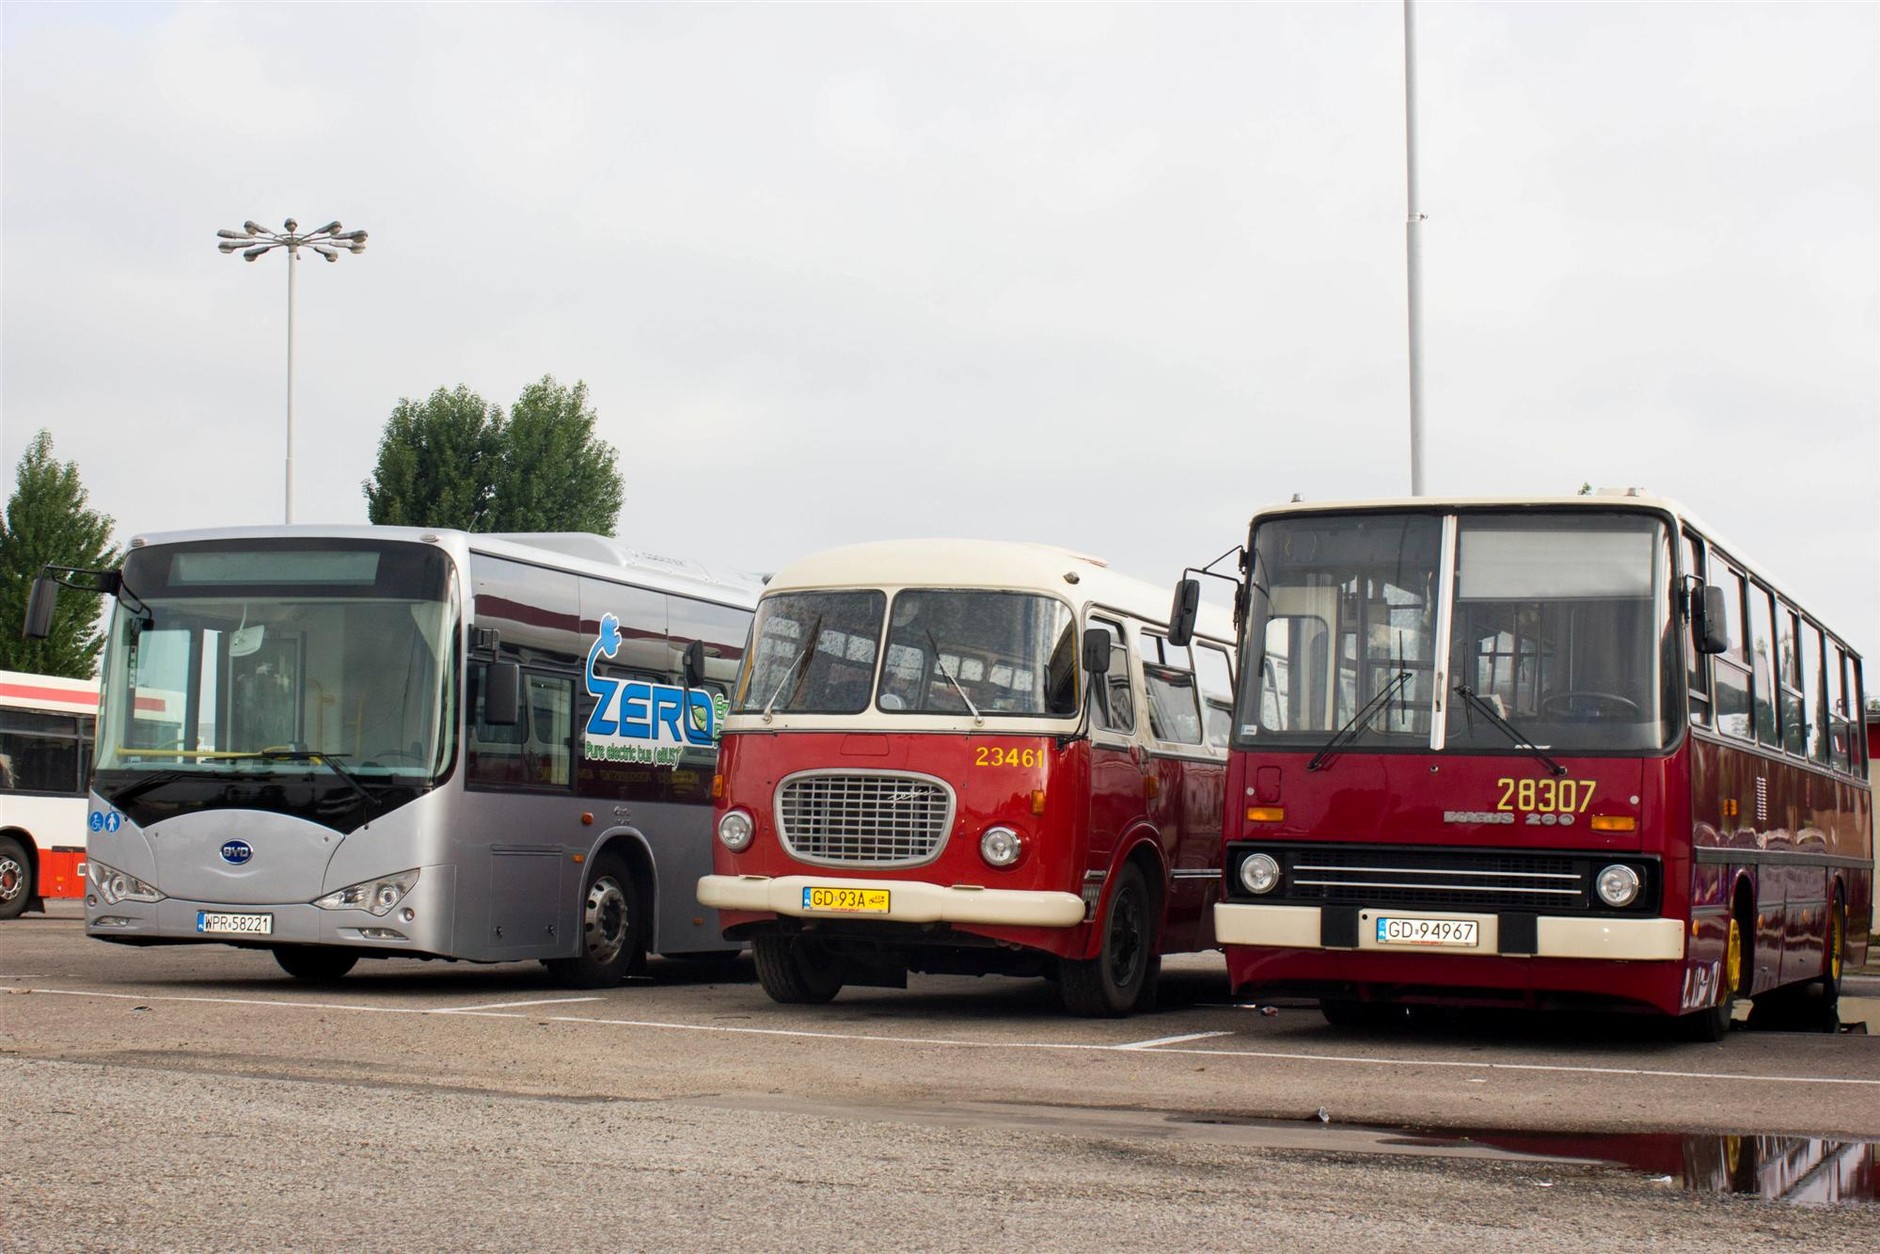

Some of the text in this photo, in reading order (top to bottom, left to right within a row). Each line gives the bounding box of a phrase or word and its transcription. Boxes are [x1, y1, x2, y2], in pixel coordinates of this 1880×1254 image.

[587, 679, 713, 746] ZERO
[586, 741, 605, 759] Pure
[606, 742, 636, 761] electric
[637, 745, 652, 763] bus
[975, 746, 1043, 769] 23461
[1497, 778, 1597, 813] 28307
[223, 846, 249, 857] BYD
[813, 890, 866, 907] GD 93A
[205, 915, 268, 932] WPR 58221
[1388, 921, 1413, 938] GD
[1420, 922, 1474, 940] 94967
